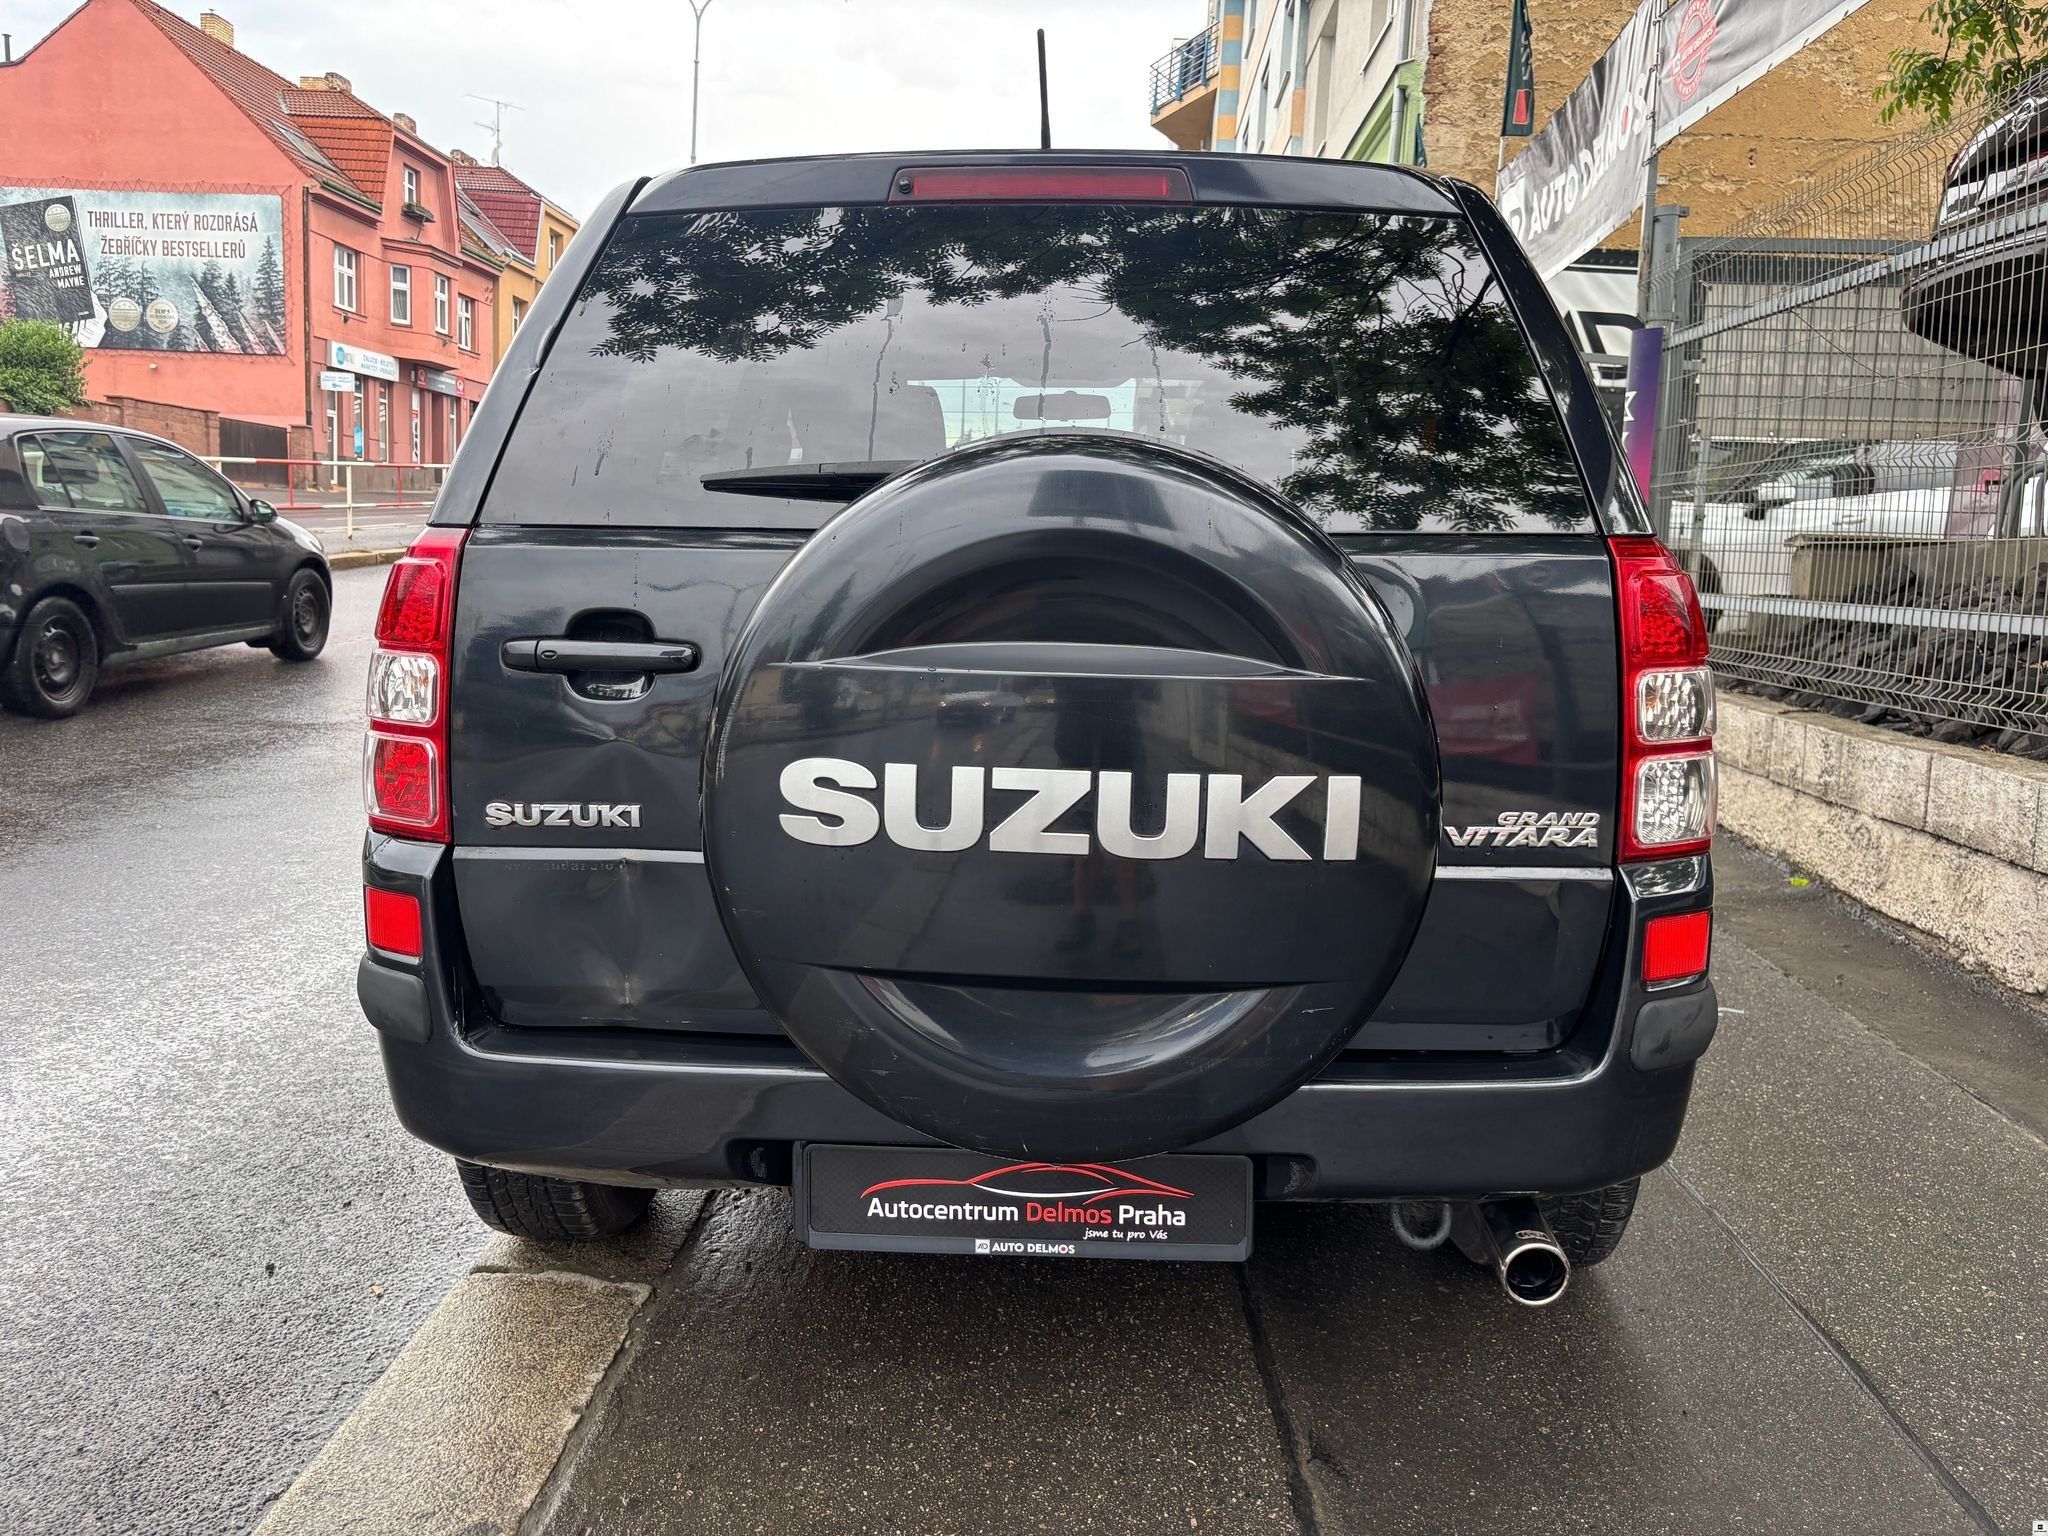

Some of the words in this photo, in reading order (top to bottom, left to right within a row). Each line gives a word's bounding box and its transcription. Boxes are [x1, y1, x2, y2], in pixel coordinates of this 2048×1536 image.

[1527, 164, 1579, 241] AUTO
[87, 210, 147, 230] THRILLER,
[152, 210, 189, 231] KTERÝ
[194, 211, 258, 233] ROZDRÁSÁ
[11, 238, 81, 271] ŠELMA
[100, 234, 157, 257] ŽEBŘÍČKY
[162, 238, 246, 259] BESTSELLERŮ
[49, 263, 82, 279] ANDREW
[57, 275, 86, 289] MAYNE
[485, 802, 641, 828] SUZUKI
[778, 757, 1362, 861] SUZUKI
[1497, 811, 1601, 826] GRAND
[1443, 826, 1598, 848] VITARA
[867, 1197, 1019, 1221] Autocentrum
[1026, 1201, 1113, 1225] Delmos
[1118, 1204, 1186, 1226] Praha
[1083, 1227, 1109, 1240] jsme
[1112, 1229, 1124, 1240] tu
[1126, 1230, 1146, 1242] pro
[1150, 1229, 1168, 1240] Vás
[992, 1242, 1025, 1253] AUTO
[1027, 1243, 1076, 1254] DELMOS
